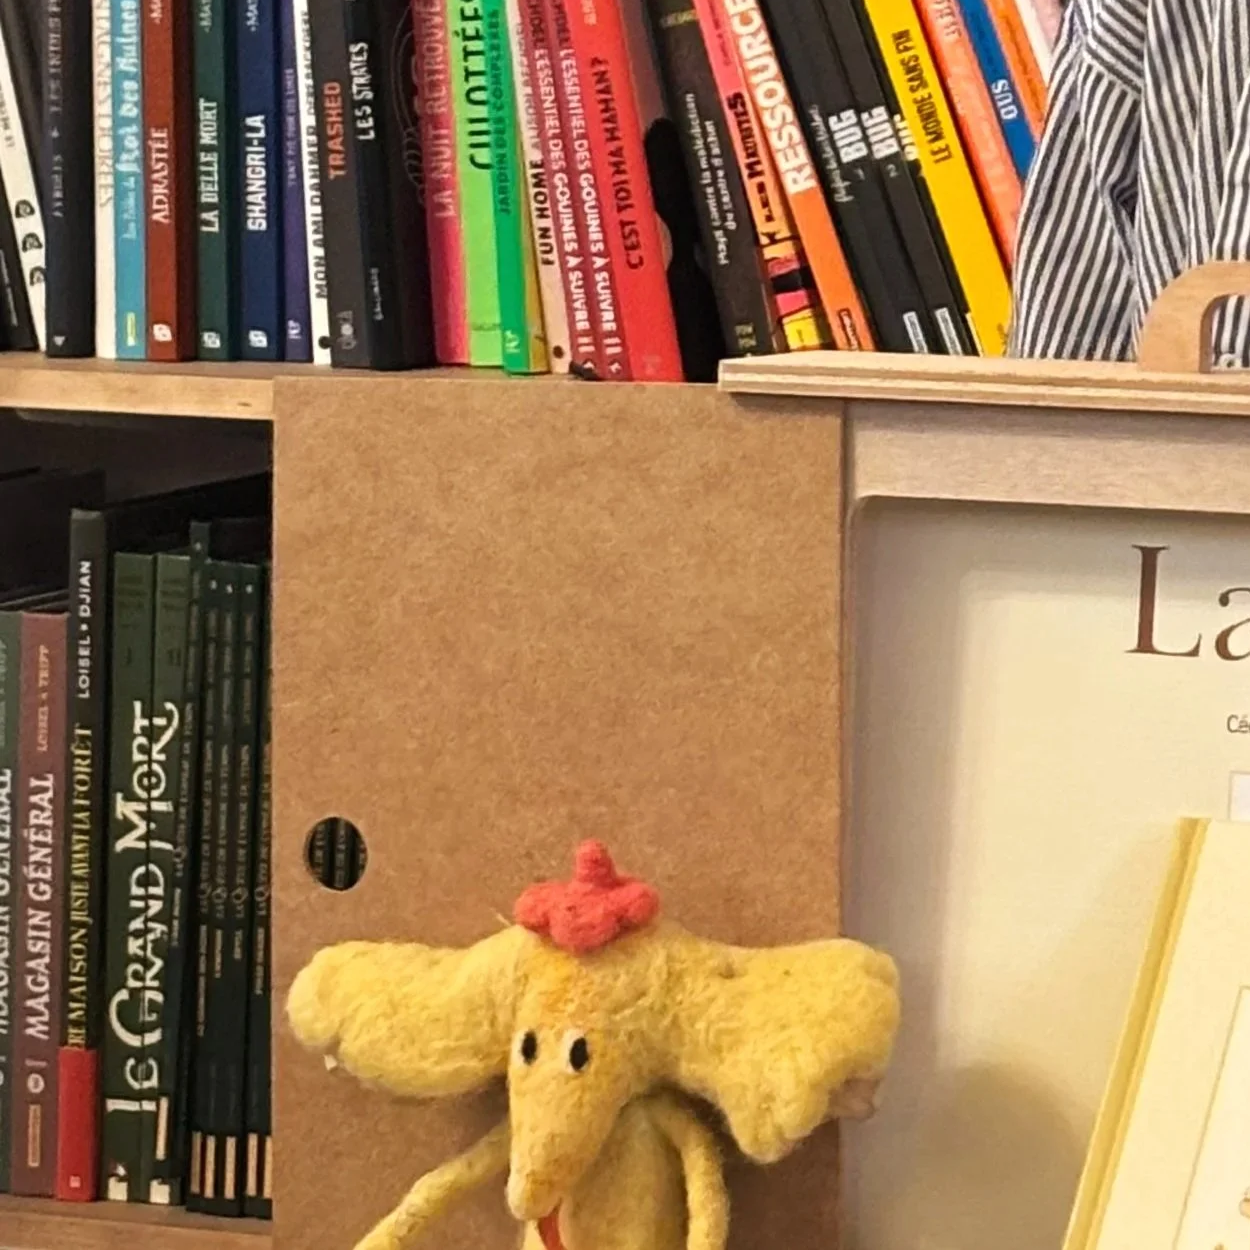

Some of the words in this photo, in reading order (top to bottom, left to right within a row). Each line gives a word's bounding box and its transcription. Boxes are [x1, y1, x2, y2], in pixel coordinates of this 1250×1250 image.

[891, 29, 917, 54] FIN
[349, 41, 374, 101] STRATES
[535, 49, 560, 136] L'ESSENTIEL
[559, 48, 585, 136] L'ESSENTIEL
[901, 53, 929, 94] SANS
[198, 98, 218, 146] MORT
[322, 81, 347, 181] TRASHED
[354, 105, 376, 141] LES
[593, 70, 621, 143] MAMAN
[860, 105, 900, 160] BUG
[913, 91, 944, 145] MONDE
[427, 123, 452, 181] NUIT
[550, 139, 567, 169] DES
[575, 138, 592, 169] DES
[606, 145, 629, 177] MA
[826, 108, 869, 164] BUG
[932, 144, 954, 165] LE
[147, 126, 171, 225] ADRASTÉE
[244, 114, 268, 232] SHANGRI-LA
[494, 152, 513, 216] JARDIN
[528, 159, 551, 220] HOME
[613, 179, 636, 215] TOI
[699, 170, 713, 184] la
[199, 210, 219, 233] LA
[432, 190, 455, 219] LA
[553, 172, 578, 252] GOUINES
[579, 172, 604, 253] GOUINES
[724, 212, 739, 231] du
[311, 213, 326, 252] AMI
[537, 226, 555, 267] FUN
[619, 218, 645, 271] C'EST
[313, 255, 328, 300] MON
[566, 270, 591, 331] SUIVRE
[593, 270, 617, 332] SUIVRE
[78, 560, 92, 618] DJIAN
[38, 644, 50, 688] TRIPP
[77, 635, 91, 699] LOISEL
[36, 706, 49, 751] LOISEL
[69, 722, 93, 807] FORÊT
[113, 700, 180, 854] MORT
[21, 772, 54, 902] GÉNÉRAL
[72, 810, 91, 829] LA
[70, 833, 90, 879] AVANT
[69, 880, 94, 925] JUSTE
[25, 907, 51, 1040] MAGASIN
[67, 927, 88, 1023] MAISON
[108, 862, 168, 1048] GRAND
